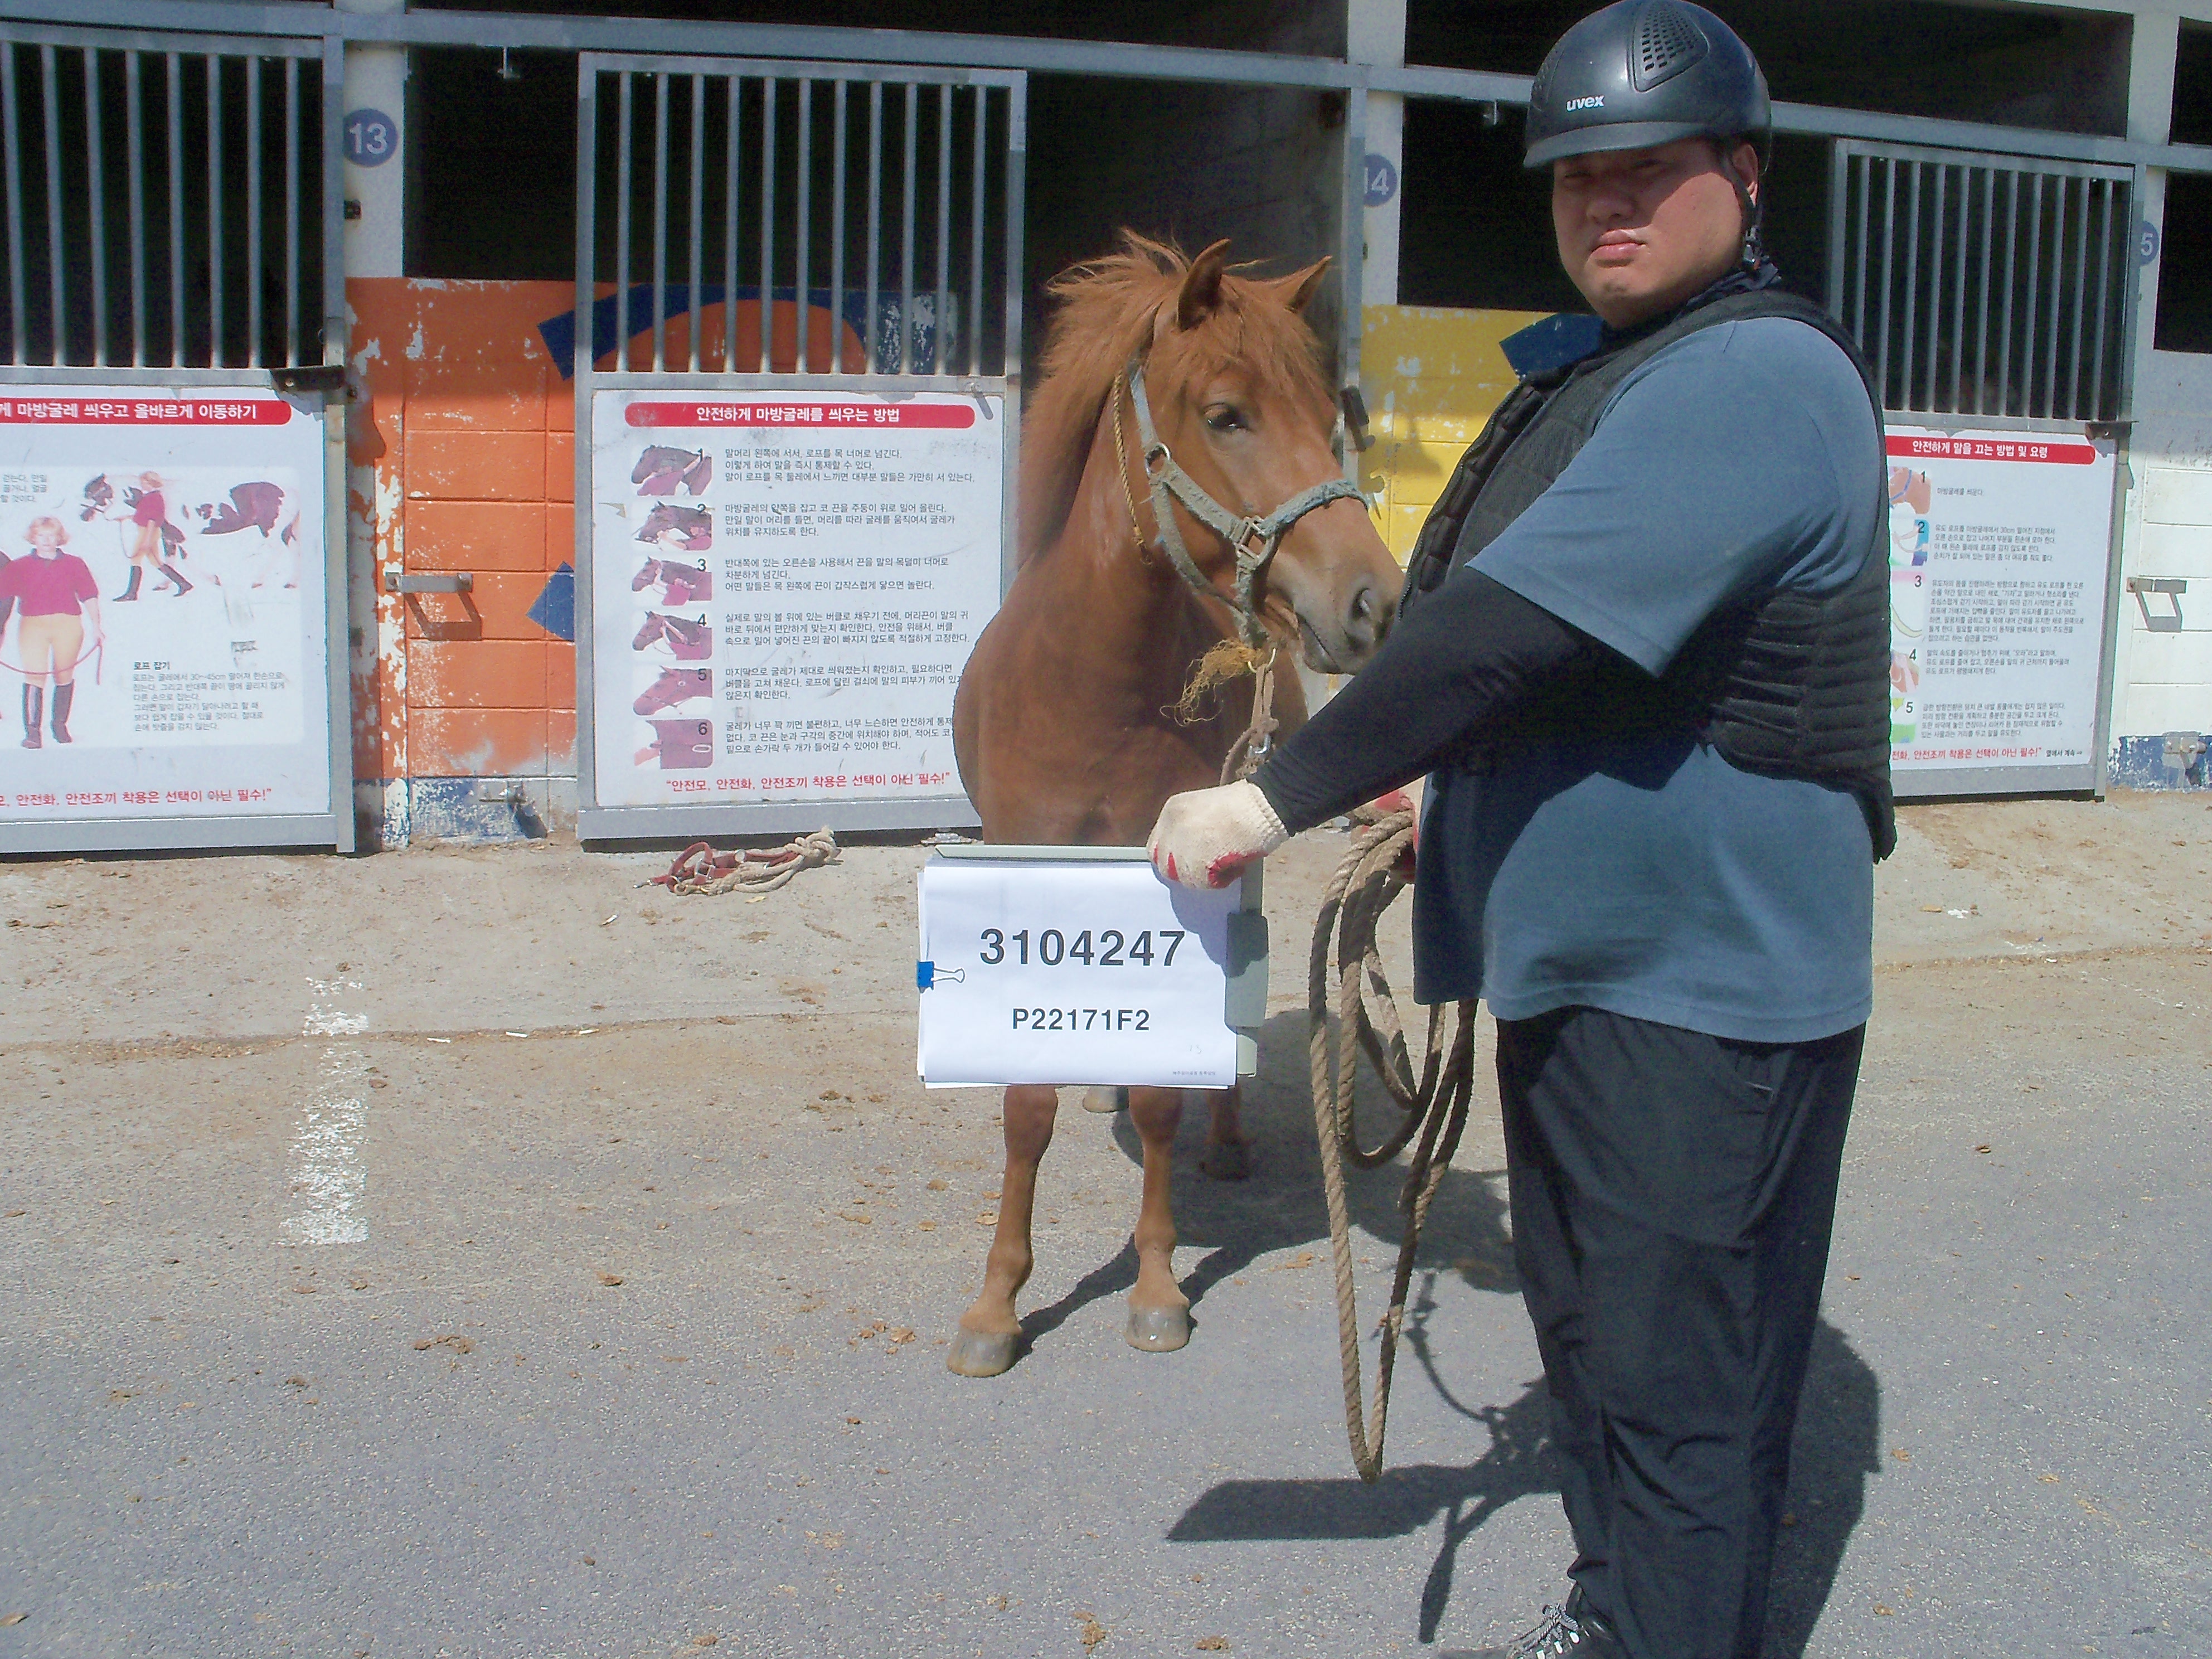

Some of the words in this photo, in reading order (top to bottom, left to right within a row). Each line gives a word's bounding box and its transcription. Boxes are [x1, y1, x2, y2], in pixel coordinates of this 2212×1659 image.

[1566, 94, 1605, 112] uvex
[349, 123, 387, 154] 13
[1364, 167, 1389, 196] 14
[2141, 232, 2153, 256] 5
[17, 402, 78, 419] 마방굴레
[84, 403, 129, 419] 씌우고
[134, 404, 193, 419] 올바르게
[199, 404, 256, 420] 이동하기
[696, 407, 751, 422] 안전하게
[756, 407, 824, 423] 마방굴레를
[828, 408, 869, 423] 씌우는
[874, 409, 899, 423] 방법
[697, 448, 704, 462] 1
[725, 449, 751, 459] 말머리
[755, 449, 780, 459] 왼쪽에
[806, 449, 831, 459] 로프를
[835, 449, 842, 459] 목
[846, 449, 872, 459] 너머로
[875, 449, 902, 459] 넘긴다.
[1912, 440, 1951, 454] 안전하게
[1953, 442, 1972, 455] 말을
[1975, 443, 1993, 457] 끄는
[1996, 444, 2015, 457] 방법
[2018, 445, 2027, 458] 및
[2029, 446, 2048, 459] 요령
[725, 460, 751, 470] 이렇게
[754, 460, 771, 470] 하여
[774, 460, 792, 470] 말을
[795, 460, 812, 470] 즉시
[815, 460, 841, 470] 통제할
[843, 460, 852, 470] 수
[855, 460, 874, 470] 있다.
[725, 473, 742, 483] 말이
[745, 472, 771, 482] 로프를
[775, 472, 783, 482] 목
[787, 472, 820, 482] 둘레에서
[823, 473, 848, 482] 느끼면
[852, 472, 877, 482] 대부분
[880, 472, 905, 482] 말들은
[908, 473, 933, 482] 가만히
[936, 473, 944, 482] 서
[948, 473, 975, 482] 있는다.
[1921, 471, 1927, 483] 1
[696, 503, 706, 514] 2
[725, 504, 768, 514] 마방굴레의
[800, 504, 817, 513] 잡고
[832, 503, 848, 513] 끈을
[851, 503, 877, 513] 주둥이
[880, 503, 896, 513] 위로
[900, 503, 916, 513] 밀어
[919, 503, 947, 513] 올린다.
[725, 516, 742, 526] 만일
[745, 516, 763, 526] 말이
[766, 515, 791, 525] 머리를
[817, 515, 842, 525] 머리를
[846, 515, 863, 525] 따라
[865, 515, 890, 525] 굴레를
[894, 515, 927, 525] 움직여서
[930, 516, 955, 525] 굴레가
[1918, 521, 1925, 533] 2
[725, 527, 751, 537] 위치를
[754, 527, 796, 537] 유지하도록
[800, 527, 819, 537] 한다.
[697, 558, 707, 572] 3
[725, 559, 759, 568] 반대쪽에
[763, 559, 780, 568] 있는
[783, 557, 816, 568] 오른손을
[819, 557, 853, 568] 사용해서
[856, 557, 873, 567] 끈을
[876, 558, 893, 567] 말의
[896, 557, 921, 567] 목덜미
[924, 557, 949, 567] 너머로
[725, 570, 759, 580] 차분하게
[763, 570, 791, 580] 넘긴다.
[1914, 575, 1922, 588] 3
[725, 582, 742, 592] 어떤
[745, 581, 771, 591] 말들은
[774, 581, 783, 591] 목
[786, 581, 811, 591] 왼쪽에
[814, 581, 831, 591] 끈이
[835, 580, 876, 591] 갑작스럽게
[879, 580, 904, 590] 닿으면
[907, 580, 934, 590] 놀란다.
[697, 614, 707, 627] 4
[1909, 648, 1917, 661] 4
[133, 662, 151, 671] 로프
[153, 662, 170, 671] 잡기
[725, 667, 768, 677] 마지막으로
[771, 666, 796, 677] 굴레가
[799, 666, 825, 676] 제대로
[828, 665, 870, 676] 씌워졌는지
[911, 664, 952, 674] 필요하다면
[697, 668, 707, 681] 5
[725, 691, 751, 701] 않은지
[754, 690, 790, 700] 확인한다.
[1905, 701, 1913, 714] 5
[698, 722, 708, 735] 6
[726, 745, 751, 754] 밑으로
[754, 744, 780, 754] 손가락
[783, 744, 791, 753] 두
[794, 743, 812, 753] 개가
[814, 742, 840, 753] 들어갈
[842, 742, 851, 751] 수
[853, 741, 879, 751] 있어야
[882, 741, 901, 750] 한다.
[1891, 750, 1910, 761] 전화,
[1914, 749, 1946, 760] 안전조끼
[1949, 749, 1972, 760] 착용은
[1976, 749, 1999, 759] 선택이
[2001, 748, 2017, 758] 아닌
[760, 777, 807, 790] 안전조끼
[812, 775, 847, 789] 착용은
[852, 774, 886, 787] 선택이
[891, 774, 913, 786] 아닌
[65, 792, 117, 806] 안전조끼
[122, 791, 160, 805] 착용은
[165, 790, 202, 803] 선택이
[207, 789, 232, 803] 아닌
[979, 928, 1186, 967] 3104247
[1012, 1008, 1150, 1031] P22171F2
